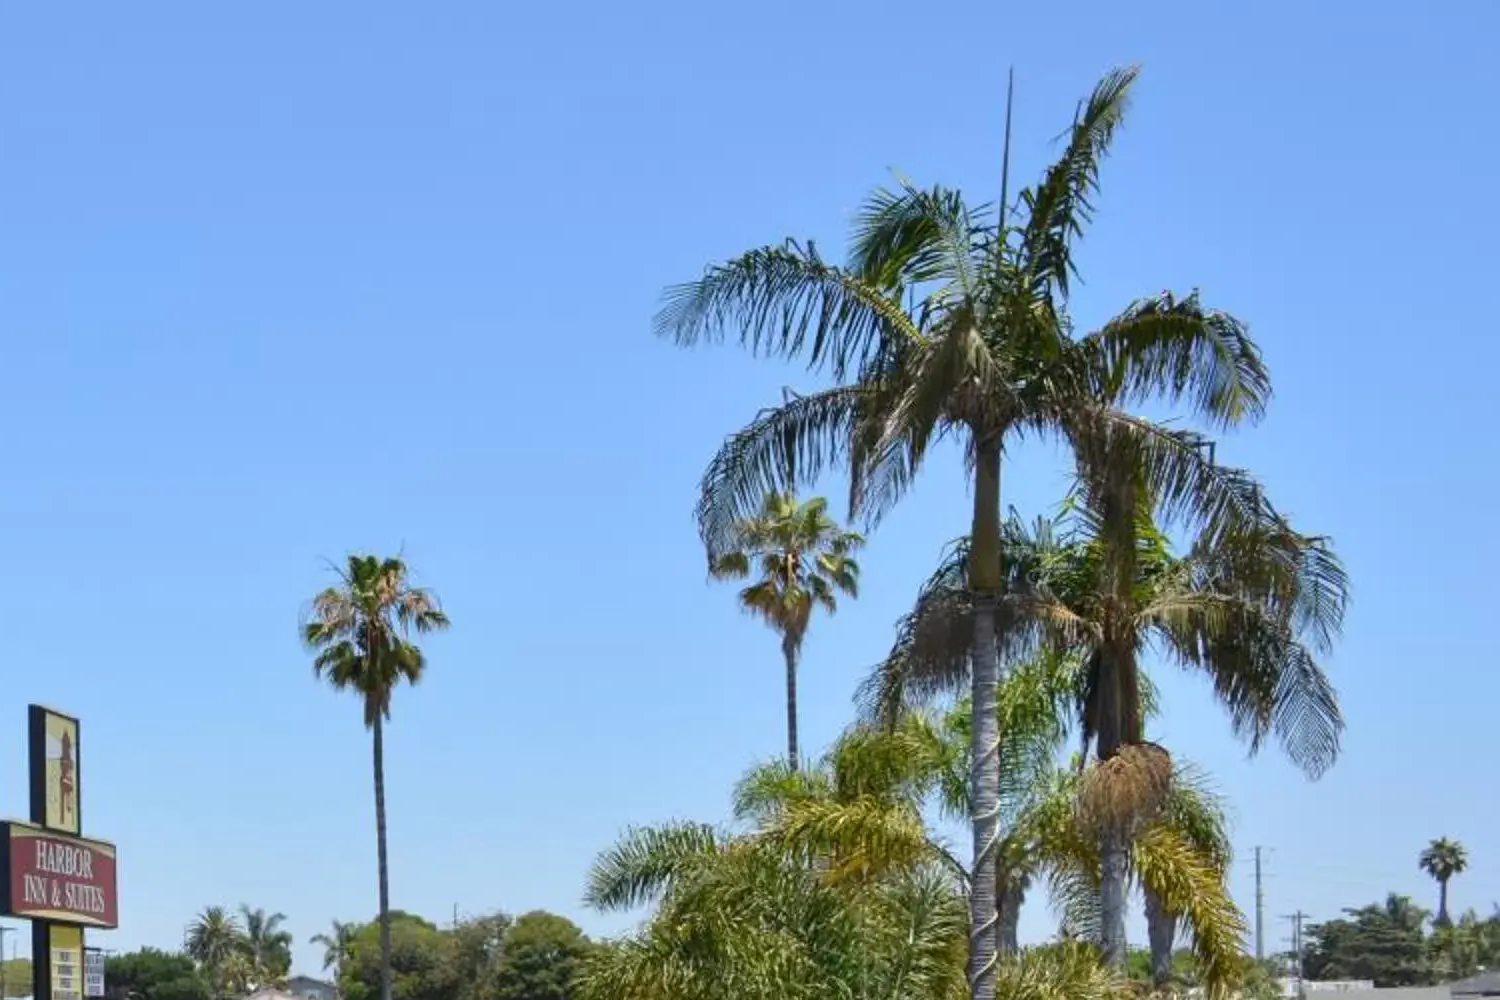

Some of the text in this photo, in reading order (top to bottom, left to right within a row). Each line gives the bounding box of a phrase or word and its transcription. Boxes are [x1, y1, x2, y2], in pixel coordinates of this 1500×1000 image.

[35, 840, 93, 880] HARBOR
[23, 874, 105, 913] INN & SUITES
